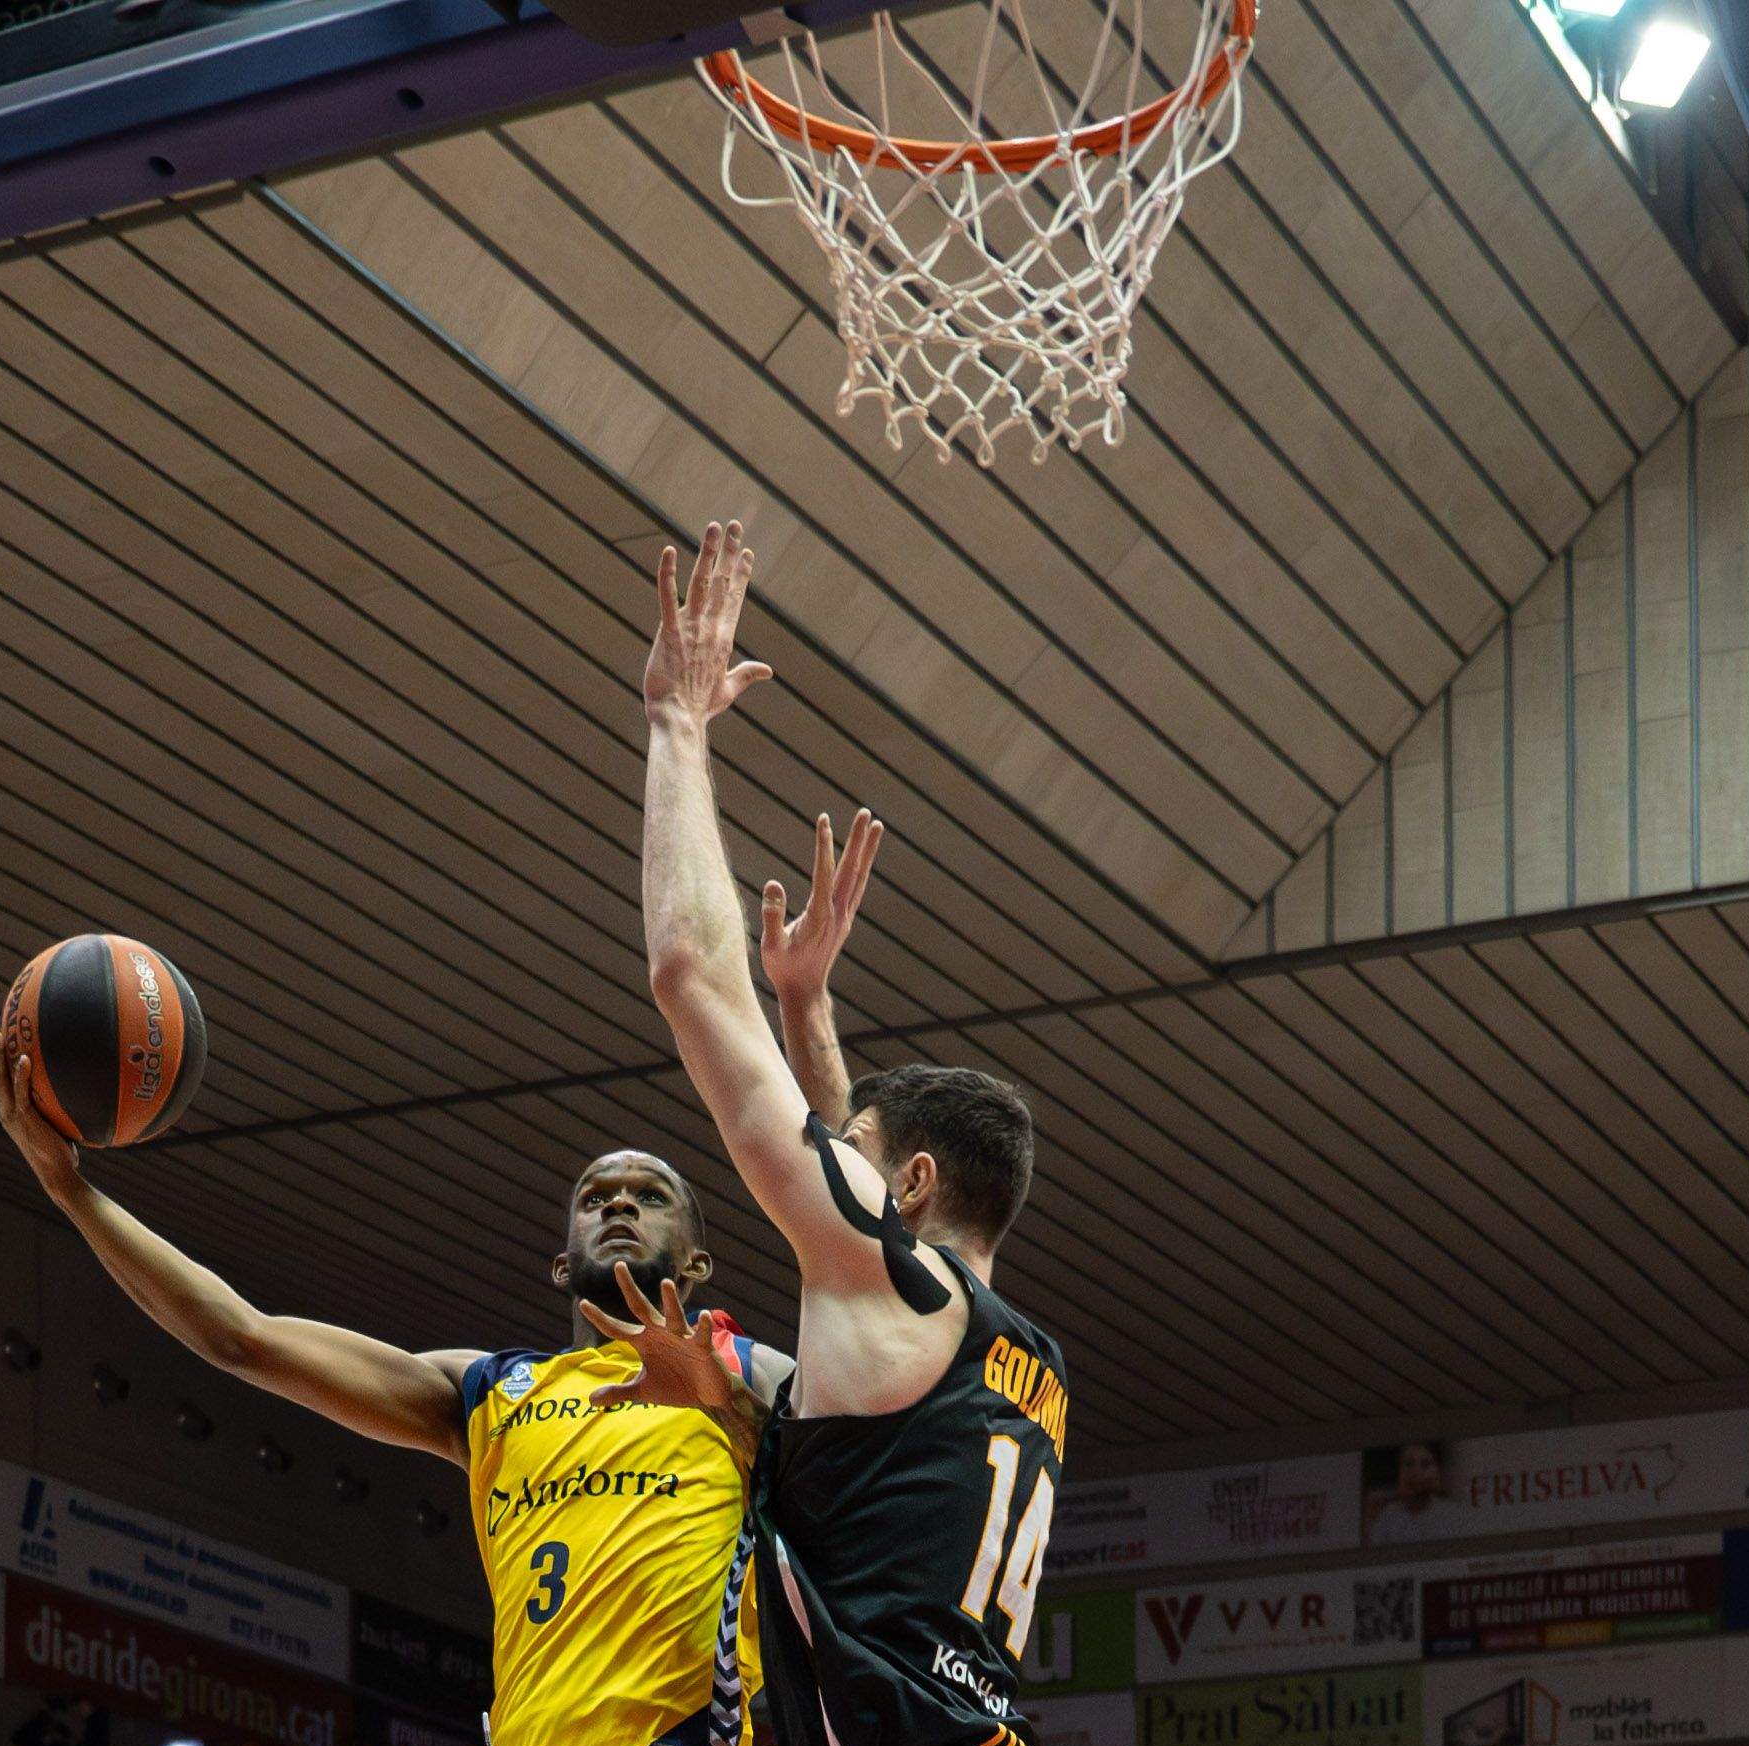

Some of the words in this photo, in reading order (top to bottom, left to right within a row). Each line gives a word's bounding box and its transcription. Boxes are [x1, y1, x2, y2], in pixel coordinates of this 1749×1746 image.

[513, 1463, 680, 1519] Andorra
[1469, 1460, 1647, 1509] FRISELVA
[526, 1540, 570, 1626] 3
[960, 1433, 1054, 1662] 14
